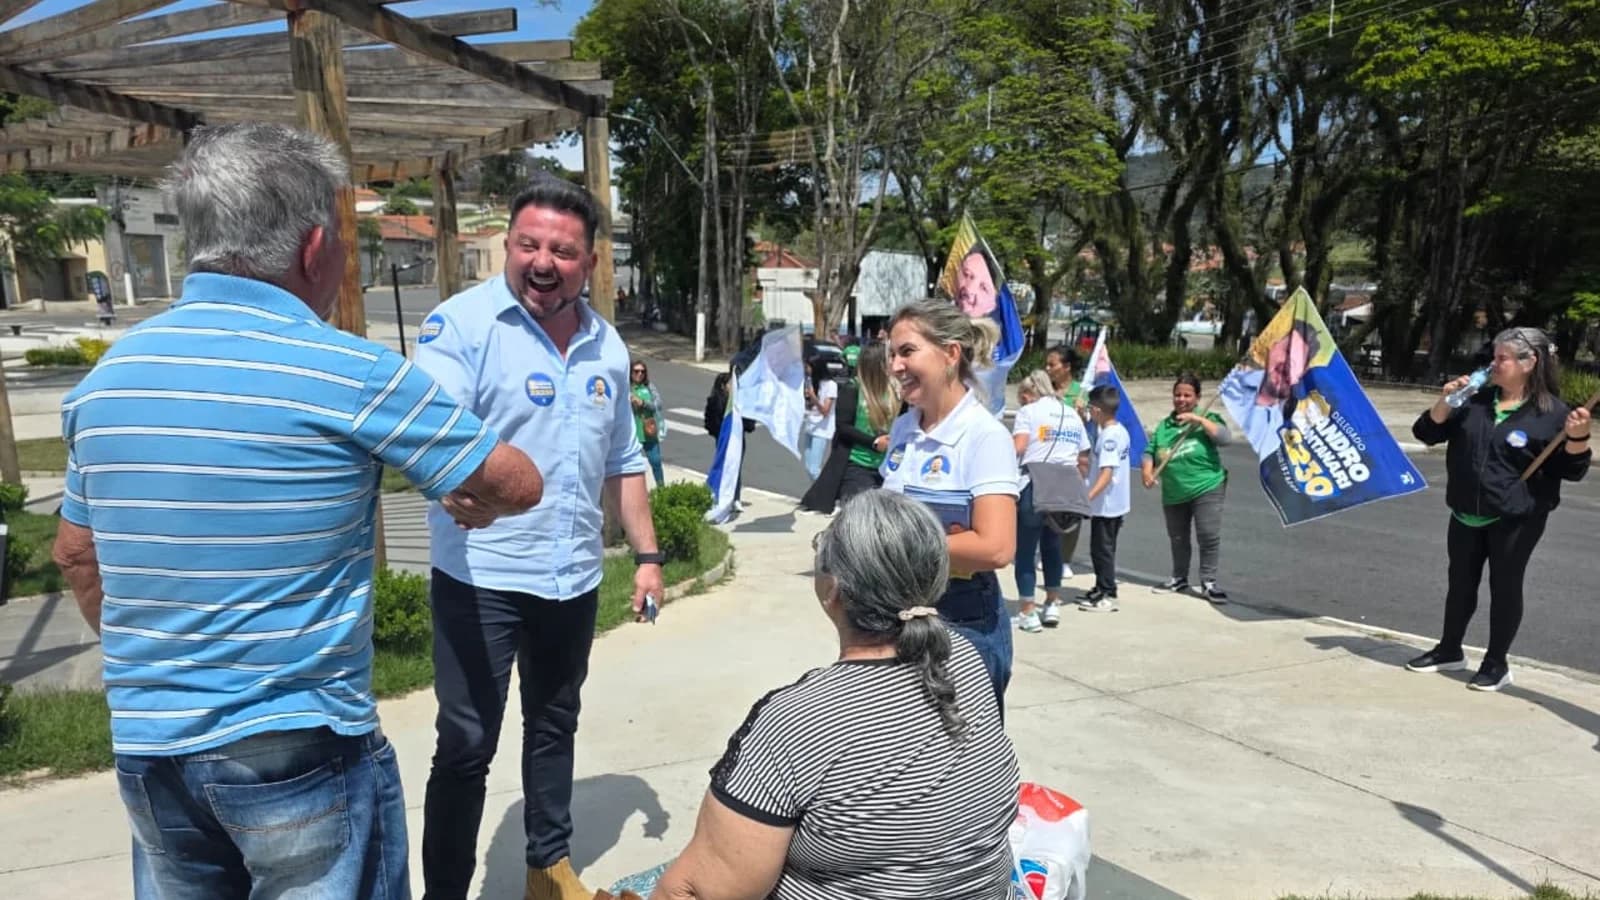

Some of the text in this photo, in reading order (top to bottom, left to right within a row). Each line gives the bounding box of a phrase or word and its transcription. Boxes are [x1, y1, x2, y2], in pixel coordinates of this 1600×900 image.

[1292, 411, 1353, 490] NTANARI
[1306, 401, 1370, 482] ANDRO
[1331, 411, 1366, 451] DELEGADO
